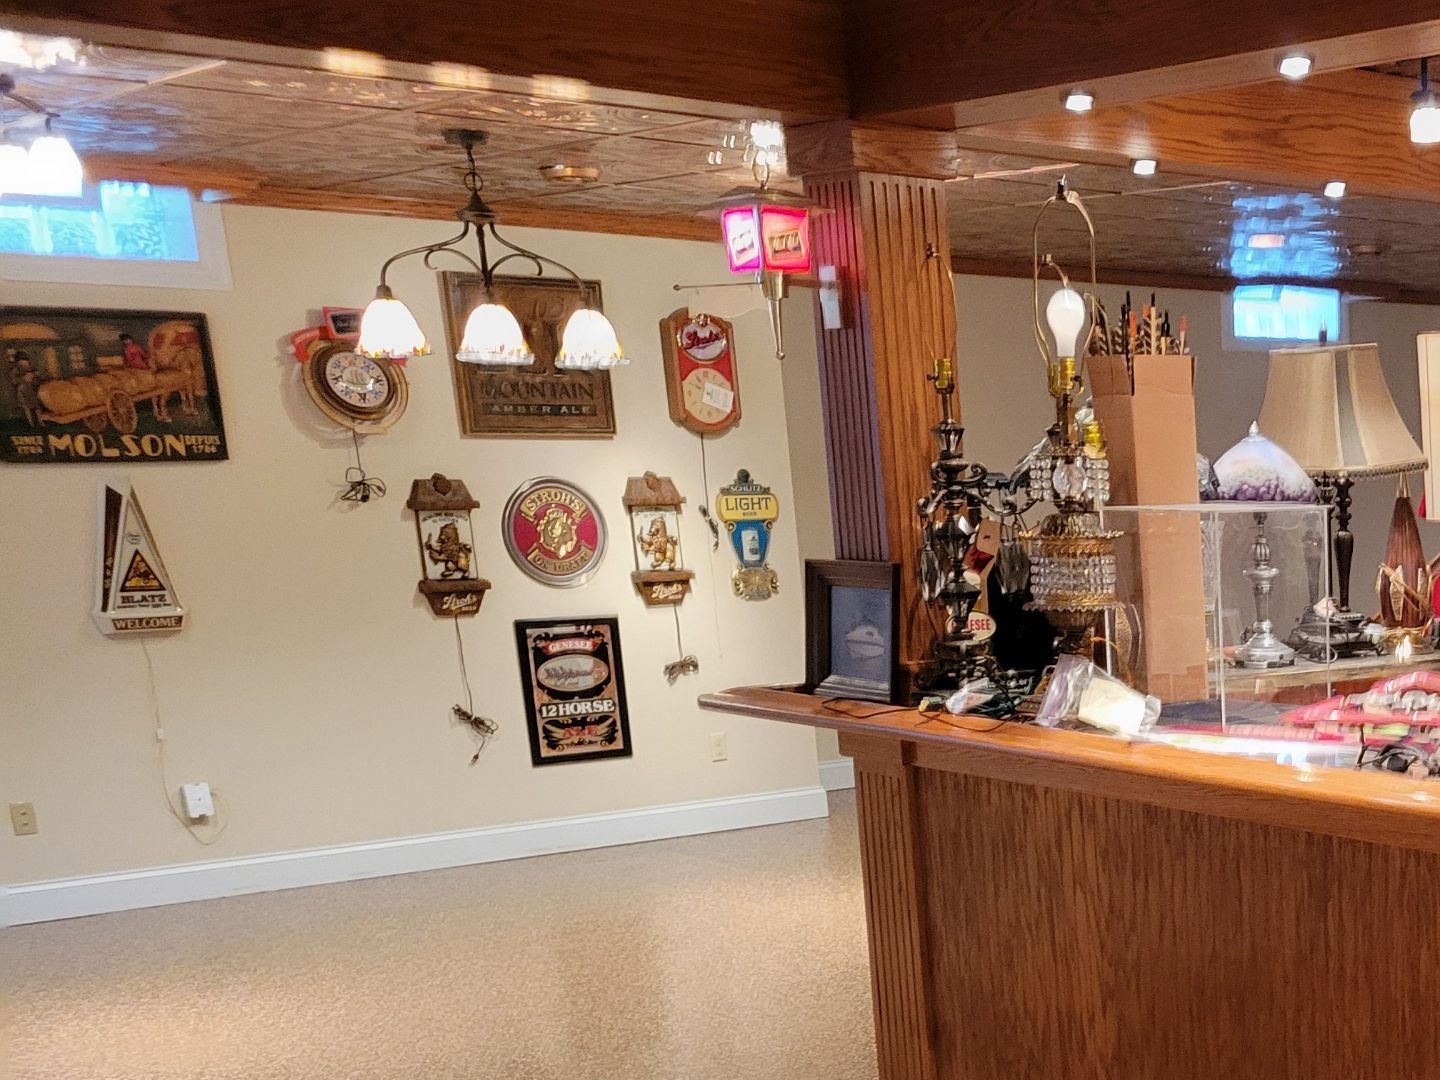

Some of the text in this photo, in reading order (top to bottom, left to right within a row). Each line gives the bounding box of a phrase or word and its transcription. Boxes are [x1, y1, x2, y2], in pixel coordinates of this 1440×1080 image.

[480, 380, 594, 400] MOUNTAIN
[492, 404, 591, 414] AMBER ALE
[48, 434, 187, 457] MOLSON
[526, 490, 582, 511] STROH'S
[725, 497, 772, 511] LIGHT
[535, 555, 548, 569] ON
[121, 594, 167, 605] BLATZ
[114, 617, 181, 629] WELCOME
[549, 640, 595, 652] GENESEE
[541, 699, 616, 718] 12 HORSE
